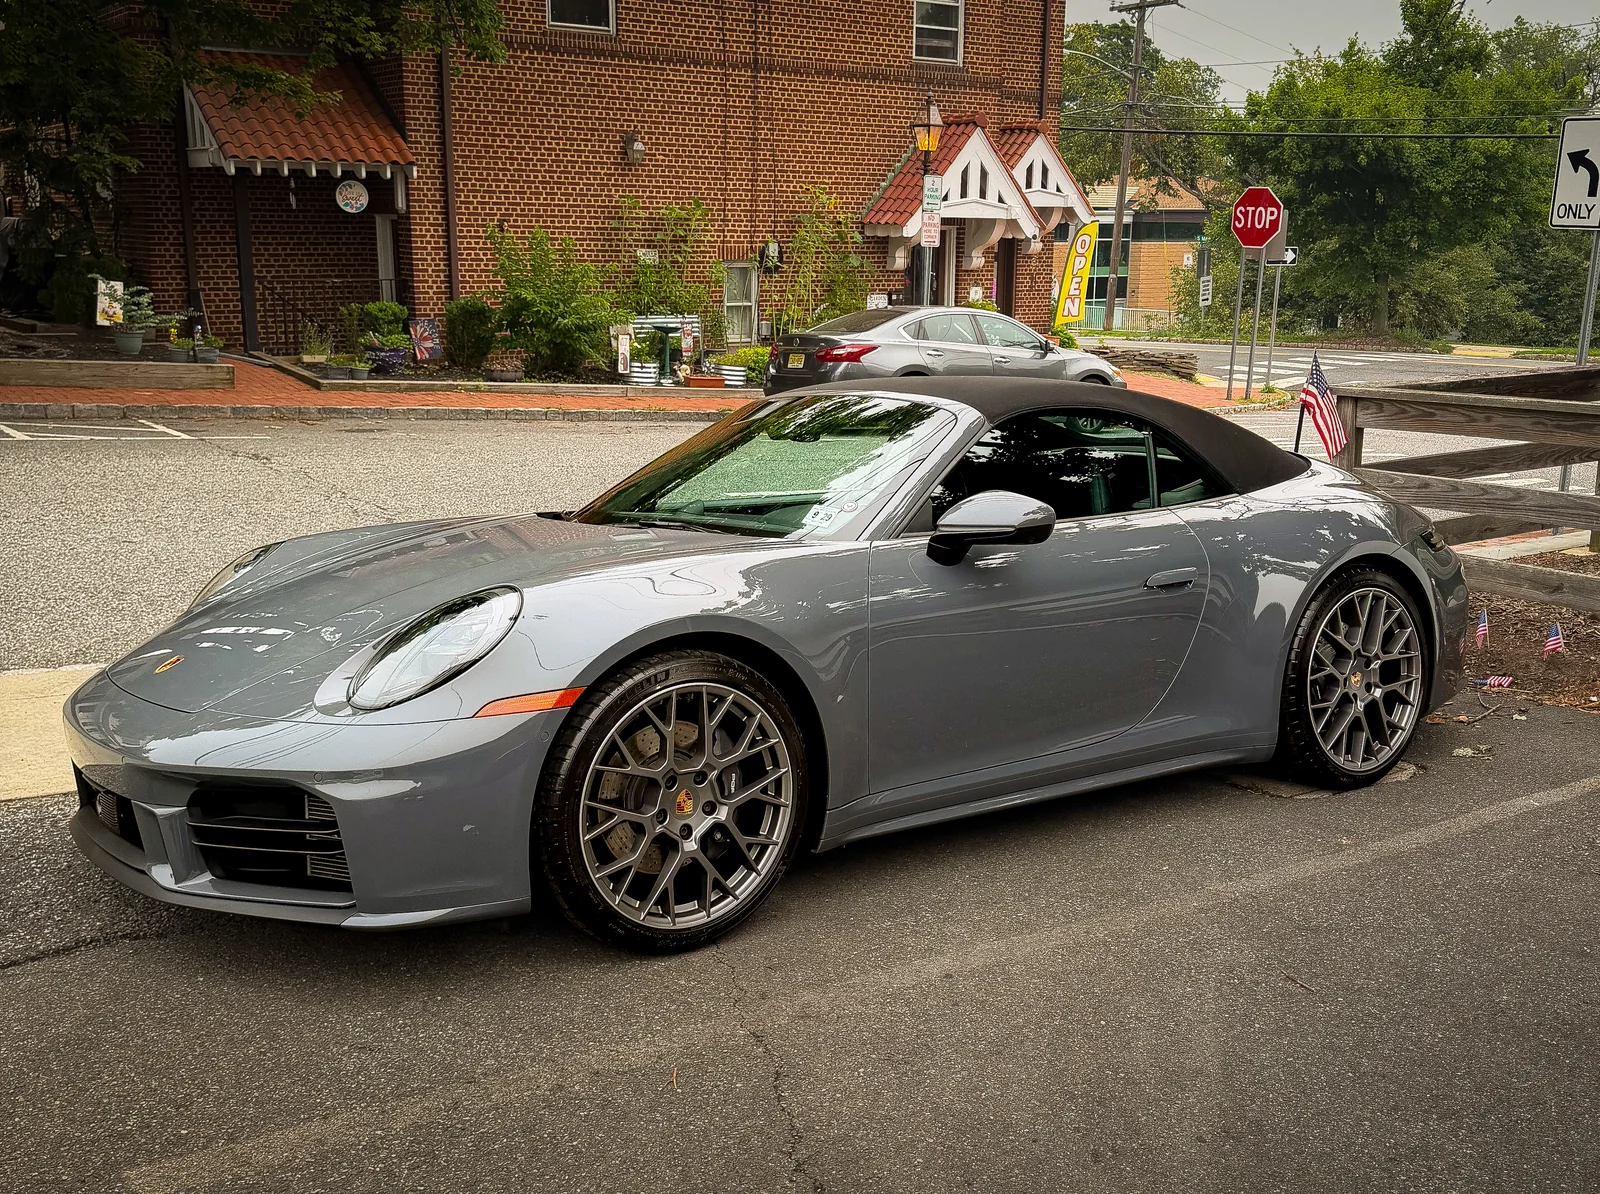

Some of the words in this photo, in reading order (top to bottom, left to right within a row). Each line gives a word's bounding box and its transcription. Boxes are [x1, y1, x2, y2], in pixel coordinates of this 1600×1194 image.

[1234, 206, 1278, 229] STOP
[1557, 203, 1597, 220] ONLY
[1062, 233, 1091, 317] OPEN
